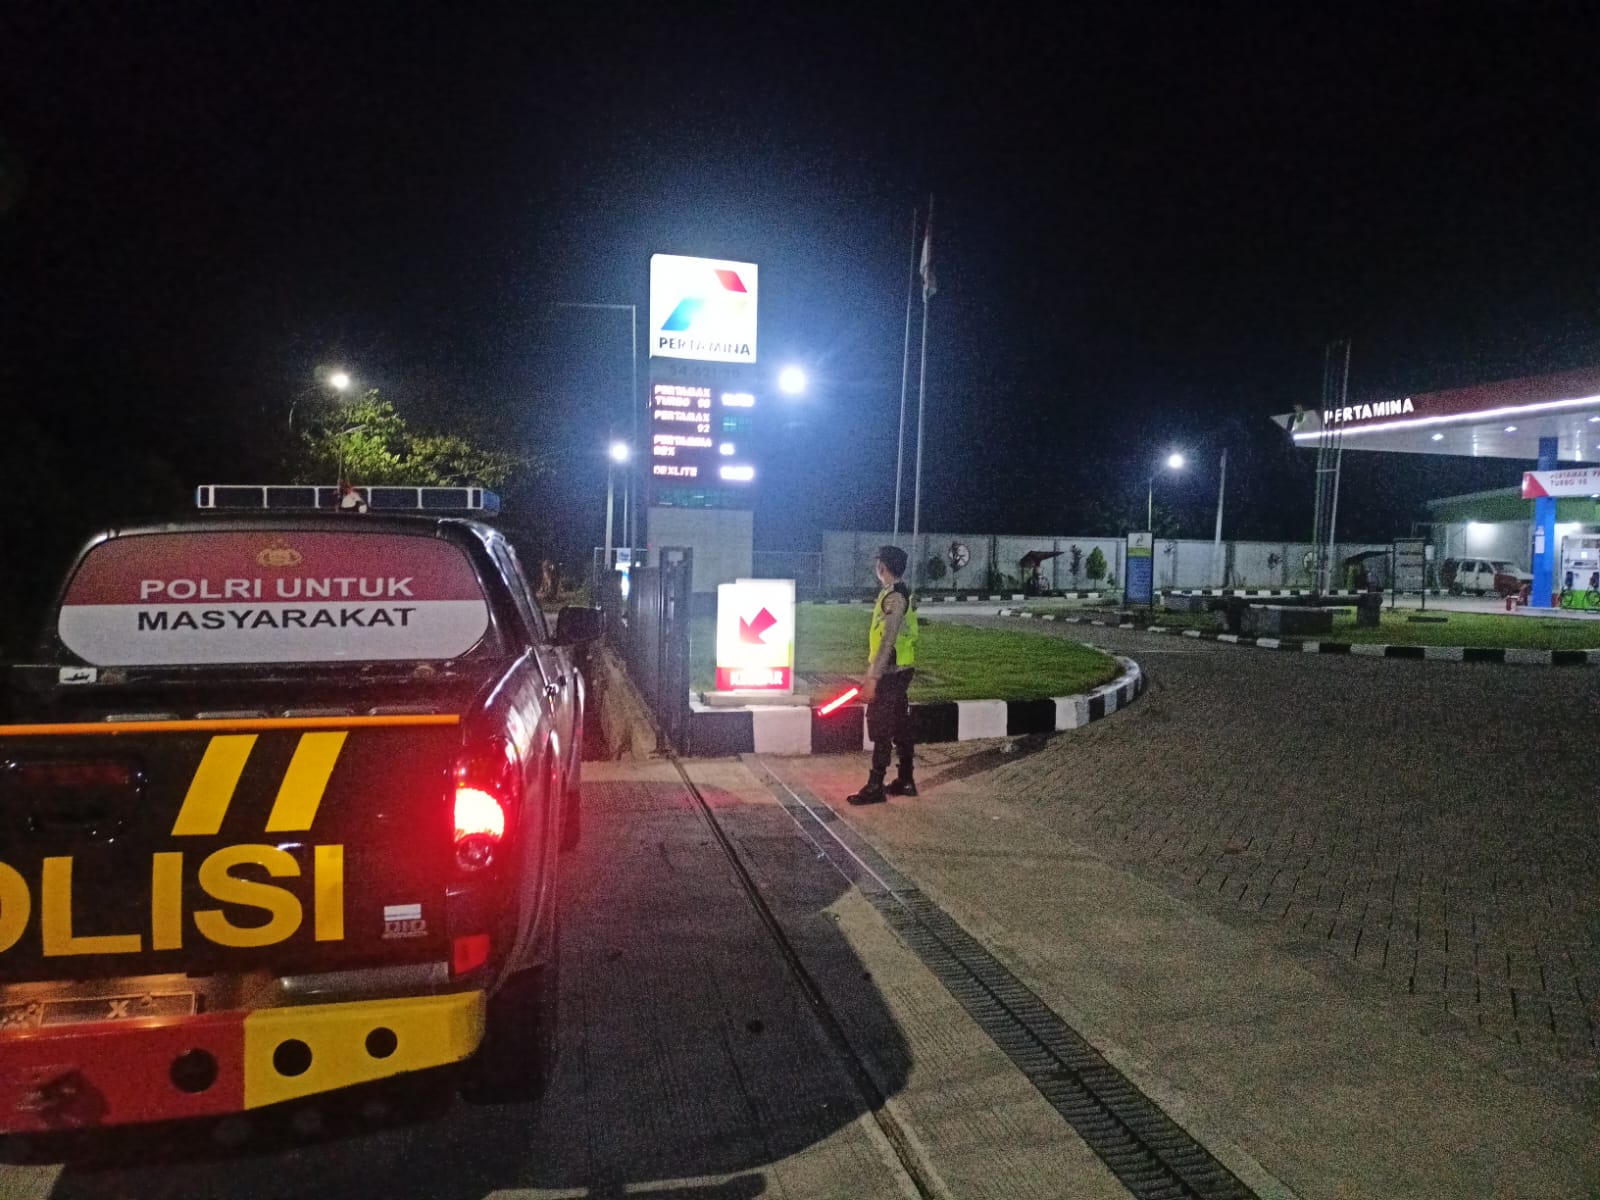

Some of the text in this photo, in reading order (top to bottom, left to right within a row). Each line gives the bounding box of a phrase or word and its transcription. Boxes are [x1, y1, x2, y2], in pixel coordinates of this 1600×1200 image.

[659, 336, 751, 356] PERTAMINA
[1323, 397, 1415, 424] PERTAMINA
[654, 434, 713, 448] PERTAA
[139, 577, 414, 600] POLRI UNTUK
[137, 608, 417, 631] MASYARAKAT
[0, 843, 345, 957] LISI
